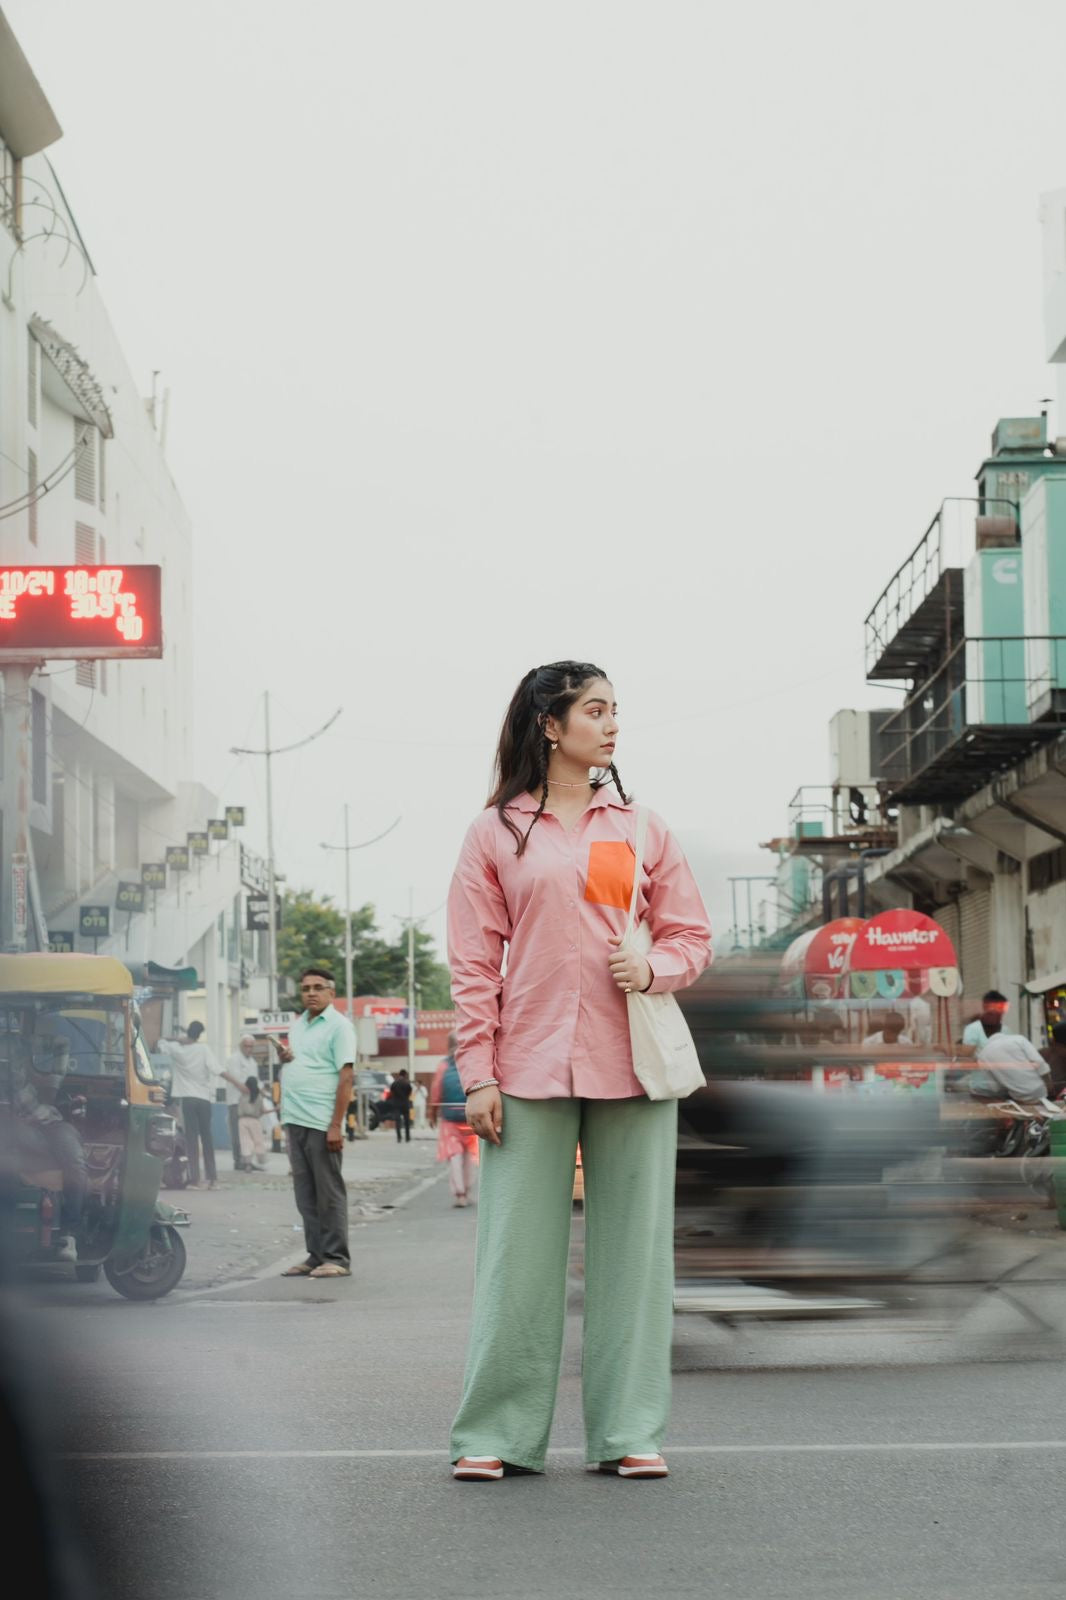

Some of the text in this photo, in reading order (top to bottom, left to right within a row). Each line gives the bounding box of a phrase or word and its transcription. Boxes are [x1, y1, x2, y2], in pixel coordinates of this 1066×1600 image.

[143, 872, 164, 881] OTB
[119, 891, 141, 902] OTB
[82, 916, 107, 927] OTB
[262, 1013, 290, 1023] OTB
